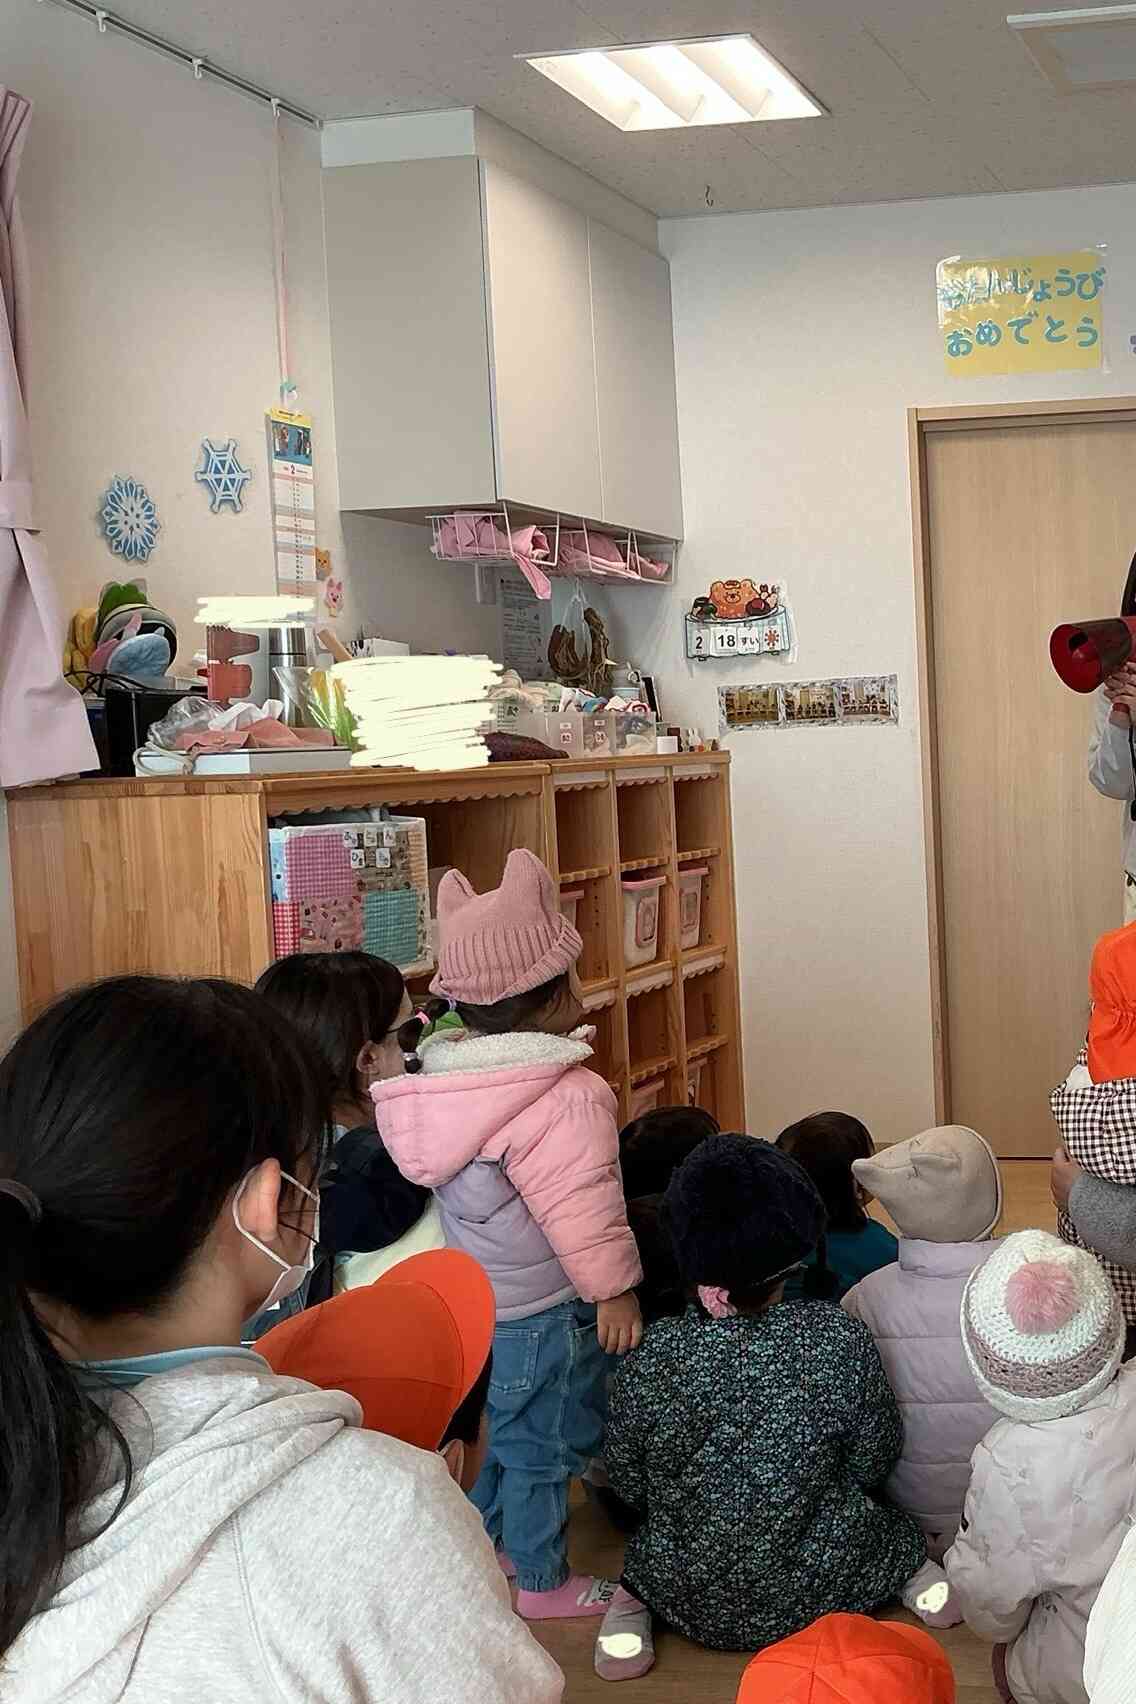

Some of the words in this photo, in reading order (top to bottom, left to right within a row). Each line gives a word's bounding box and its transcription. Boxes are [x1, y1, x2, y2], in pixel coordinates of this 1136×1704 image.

[946, 311, 1099, 357] おめでとう
[695, 636, 703, 650] 2
[717, 634, 736, 647] 18
